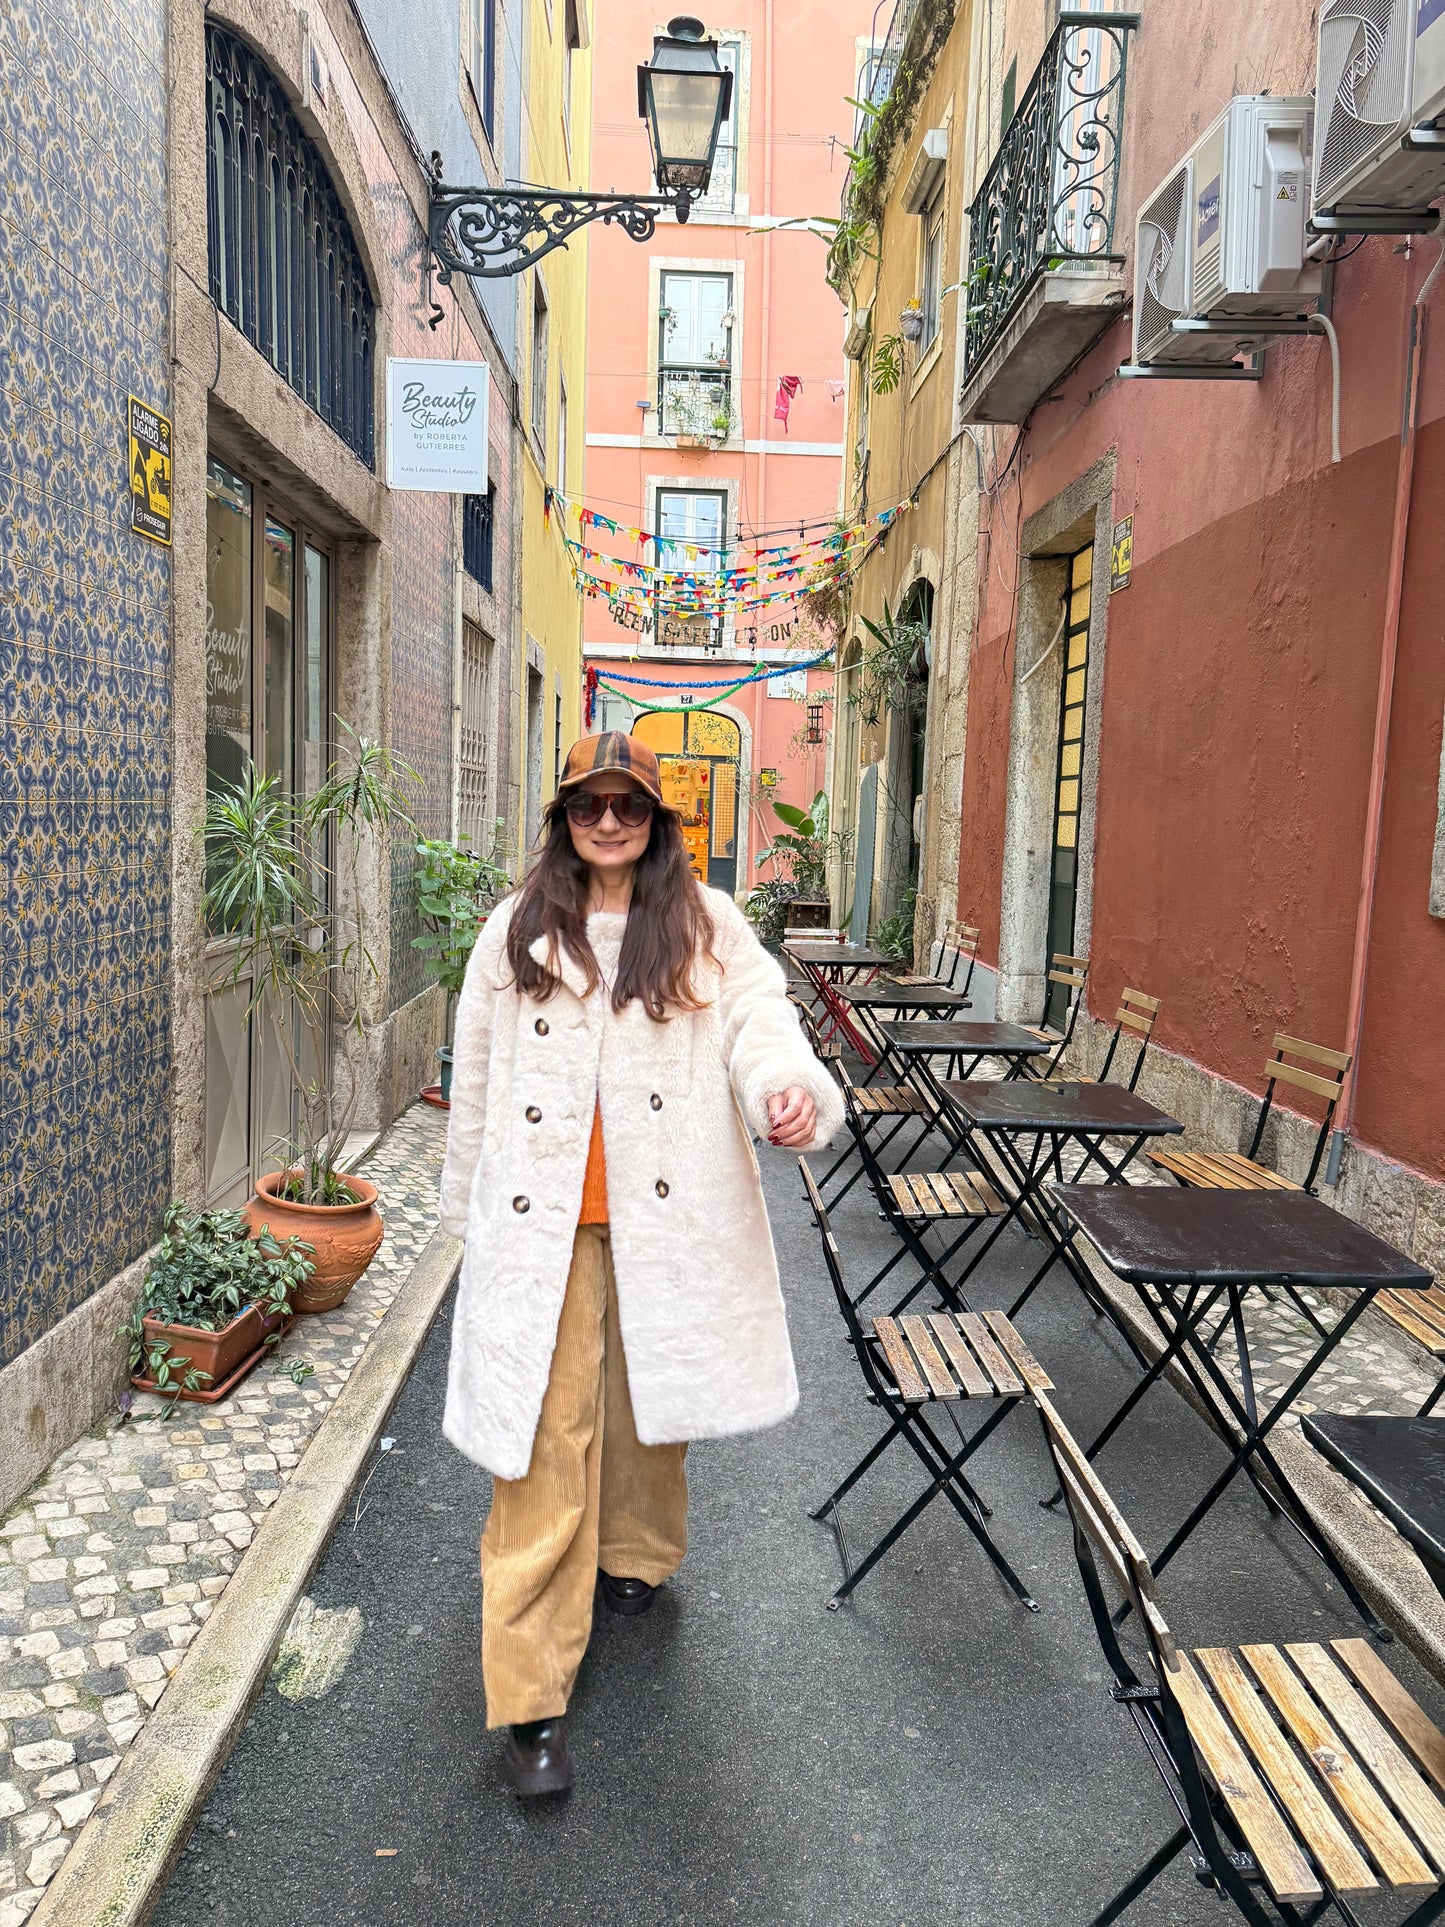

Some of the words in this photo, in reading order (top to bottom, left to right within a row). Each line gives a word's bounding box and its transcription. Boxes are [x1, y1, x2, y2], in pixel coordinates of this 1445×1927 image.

[401, 382, 477, 425] Beauty
[133, 404, 159, 431] ALARME
[410, 408, 459, 429] Studio
[132, 415, 159, 443] LIGADO
[413, 432, 424, 441] by
[426, 432, 468, 441] ROBERTA
[416, 442, 466, 451] GUTIERRES
[143, 512, 167, 531] PROSEGUR
[734, 622, 791, 645] LISON
[205, 654, 241, 697] Studio
[682, 695, 691, 703] 27
